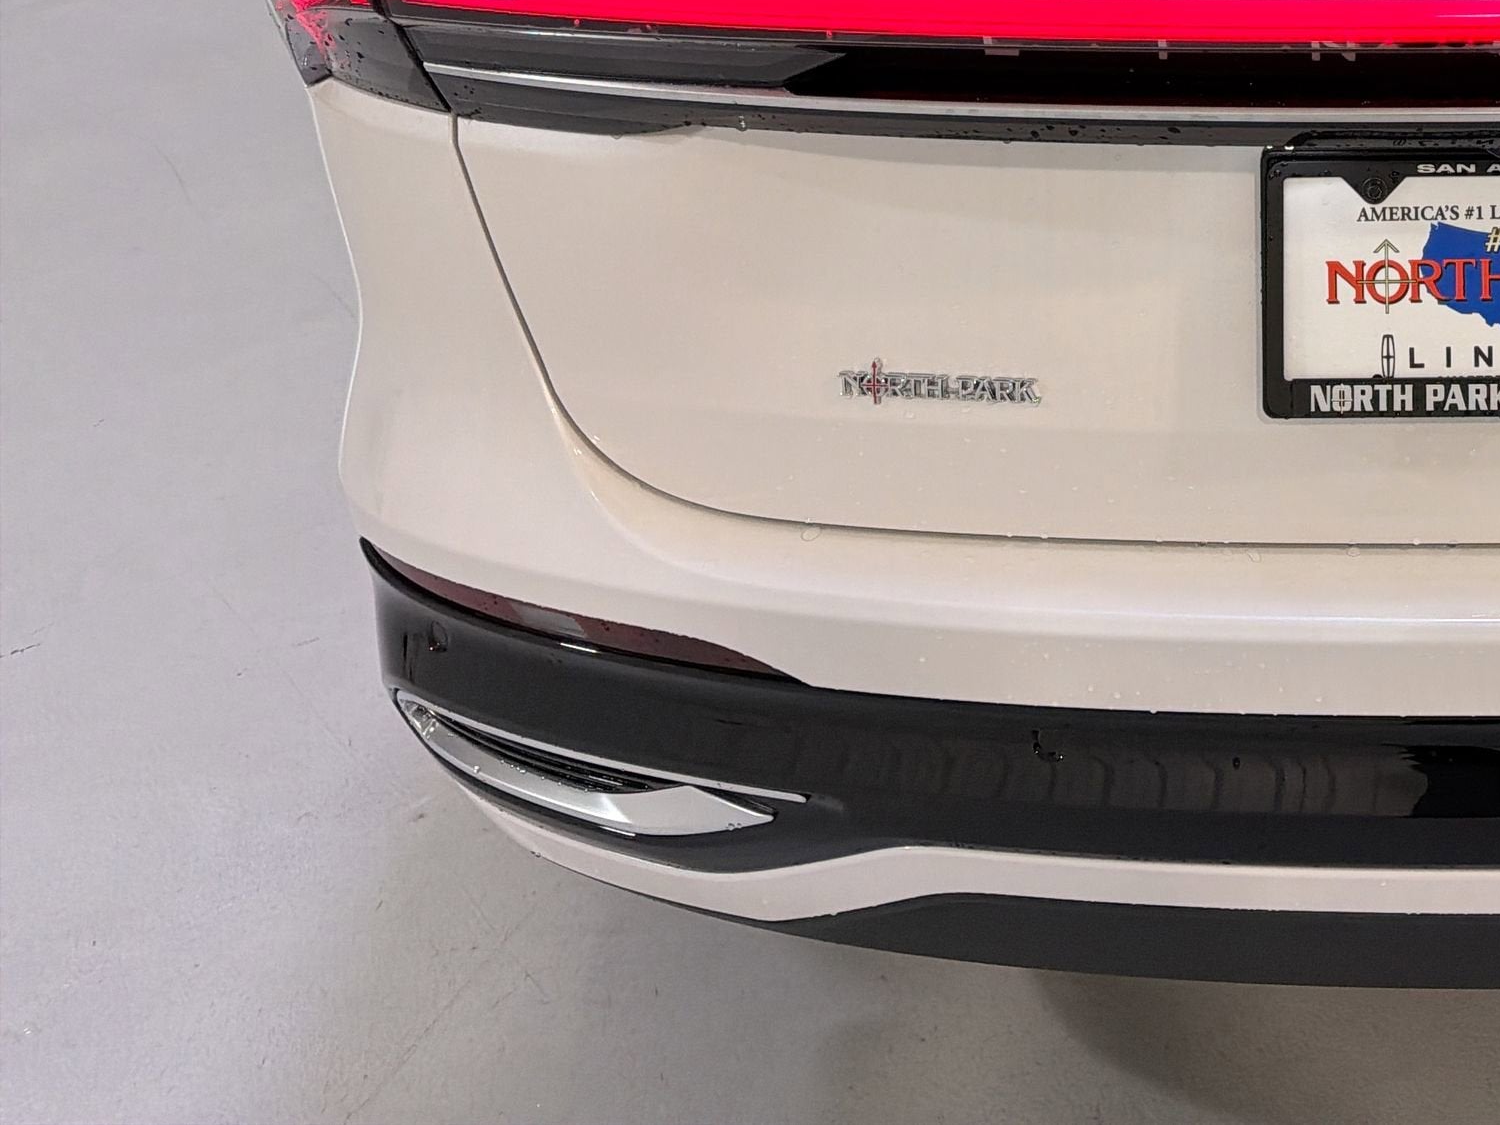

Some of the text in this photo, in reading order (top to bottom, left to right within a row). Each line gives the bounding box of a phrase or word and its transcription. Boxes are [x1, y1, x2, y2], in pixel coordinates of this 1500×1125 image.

[1416, 163, 1476, 174] SAN
[1464, 206, 1483, 220] #1
[838, 370, 1042, 406] NORTH PARK
[1310, 383, 1414, 413] NORTH
